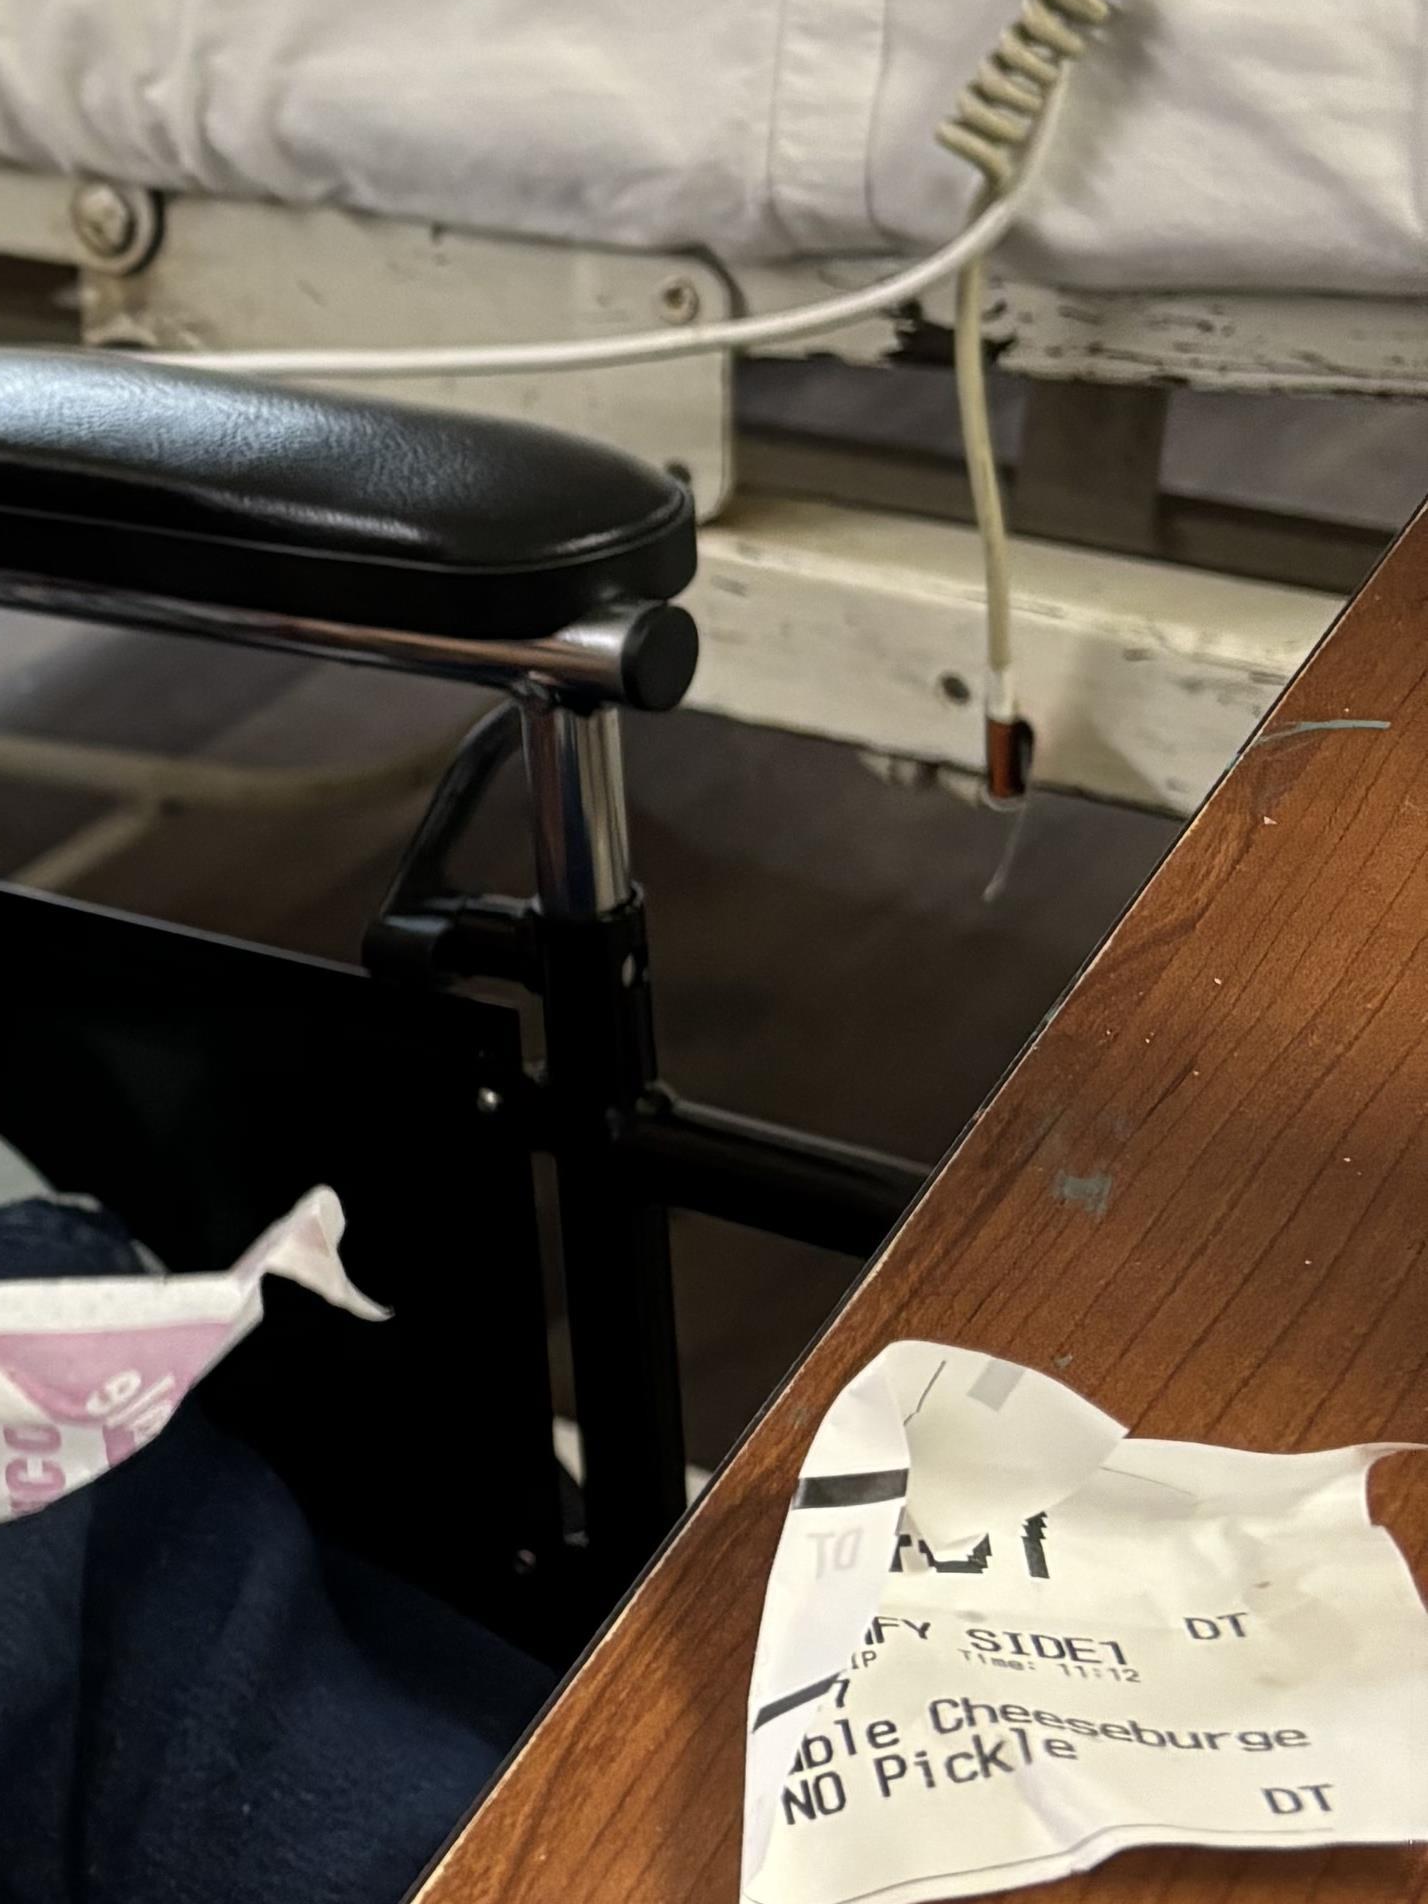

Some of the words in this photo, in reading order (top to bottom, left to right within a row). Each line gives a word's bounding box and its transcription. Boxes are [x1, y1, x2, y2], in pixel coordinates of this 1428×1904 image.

[958, 1647, 1036, 1672] Time:
[1058, 1662, 1142, 1684] 11:12
[965, 1627, 1129, 1666] SIDE1
[1185, 1612, 1248, 1640] DT
[929, 1696, 1312, 1752] Cheeseburge
[781, 1771, 847, 1825] NO
[873, 1726, 1079, 1798] Pickle
[1260, 1782, 1334, 1815] DT
